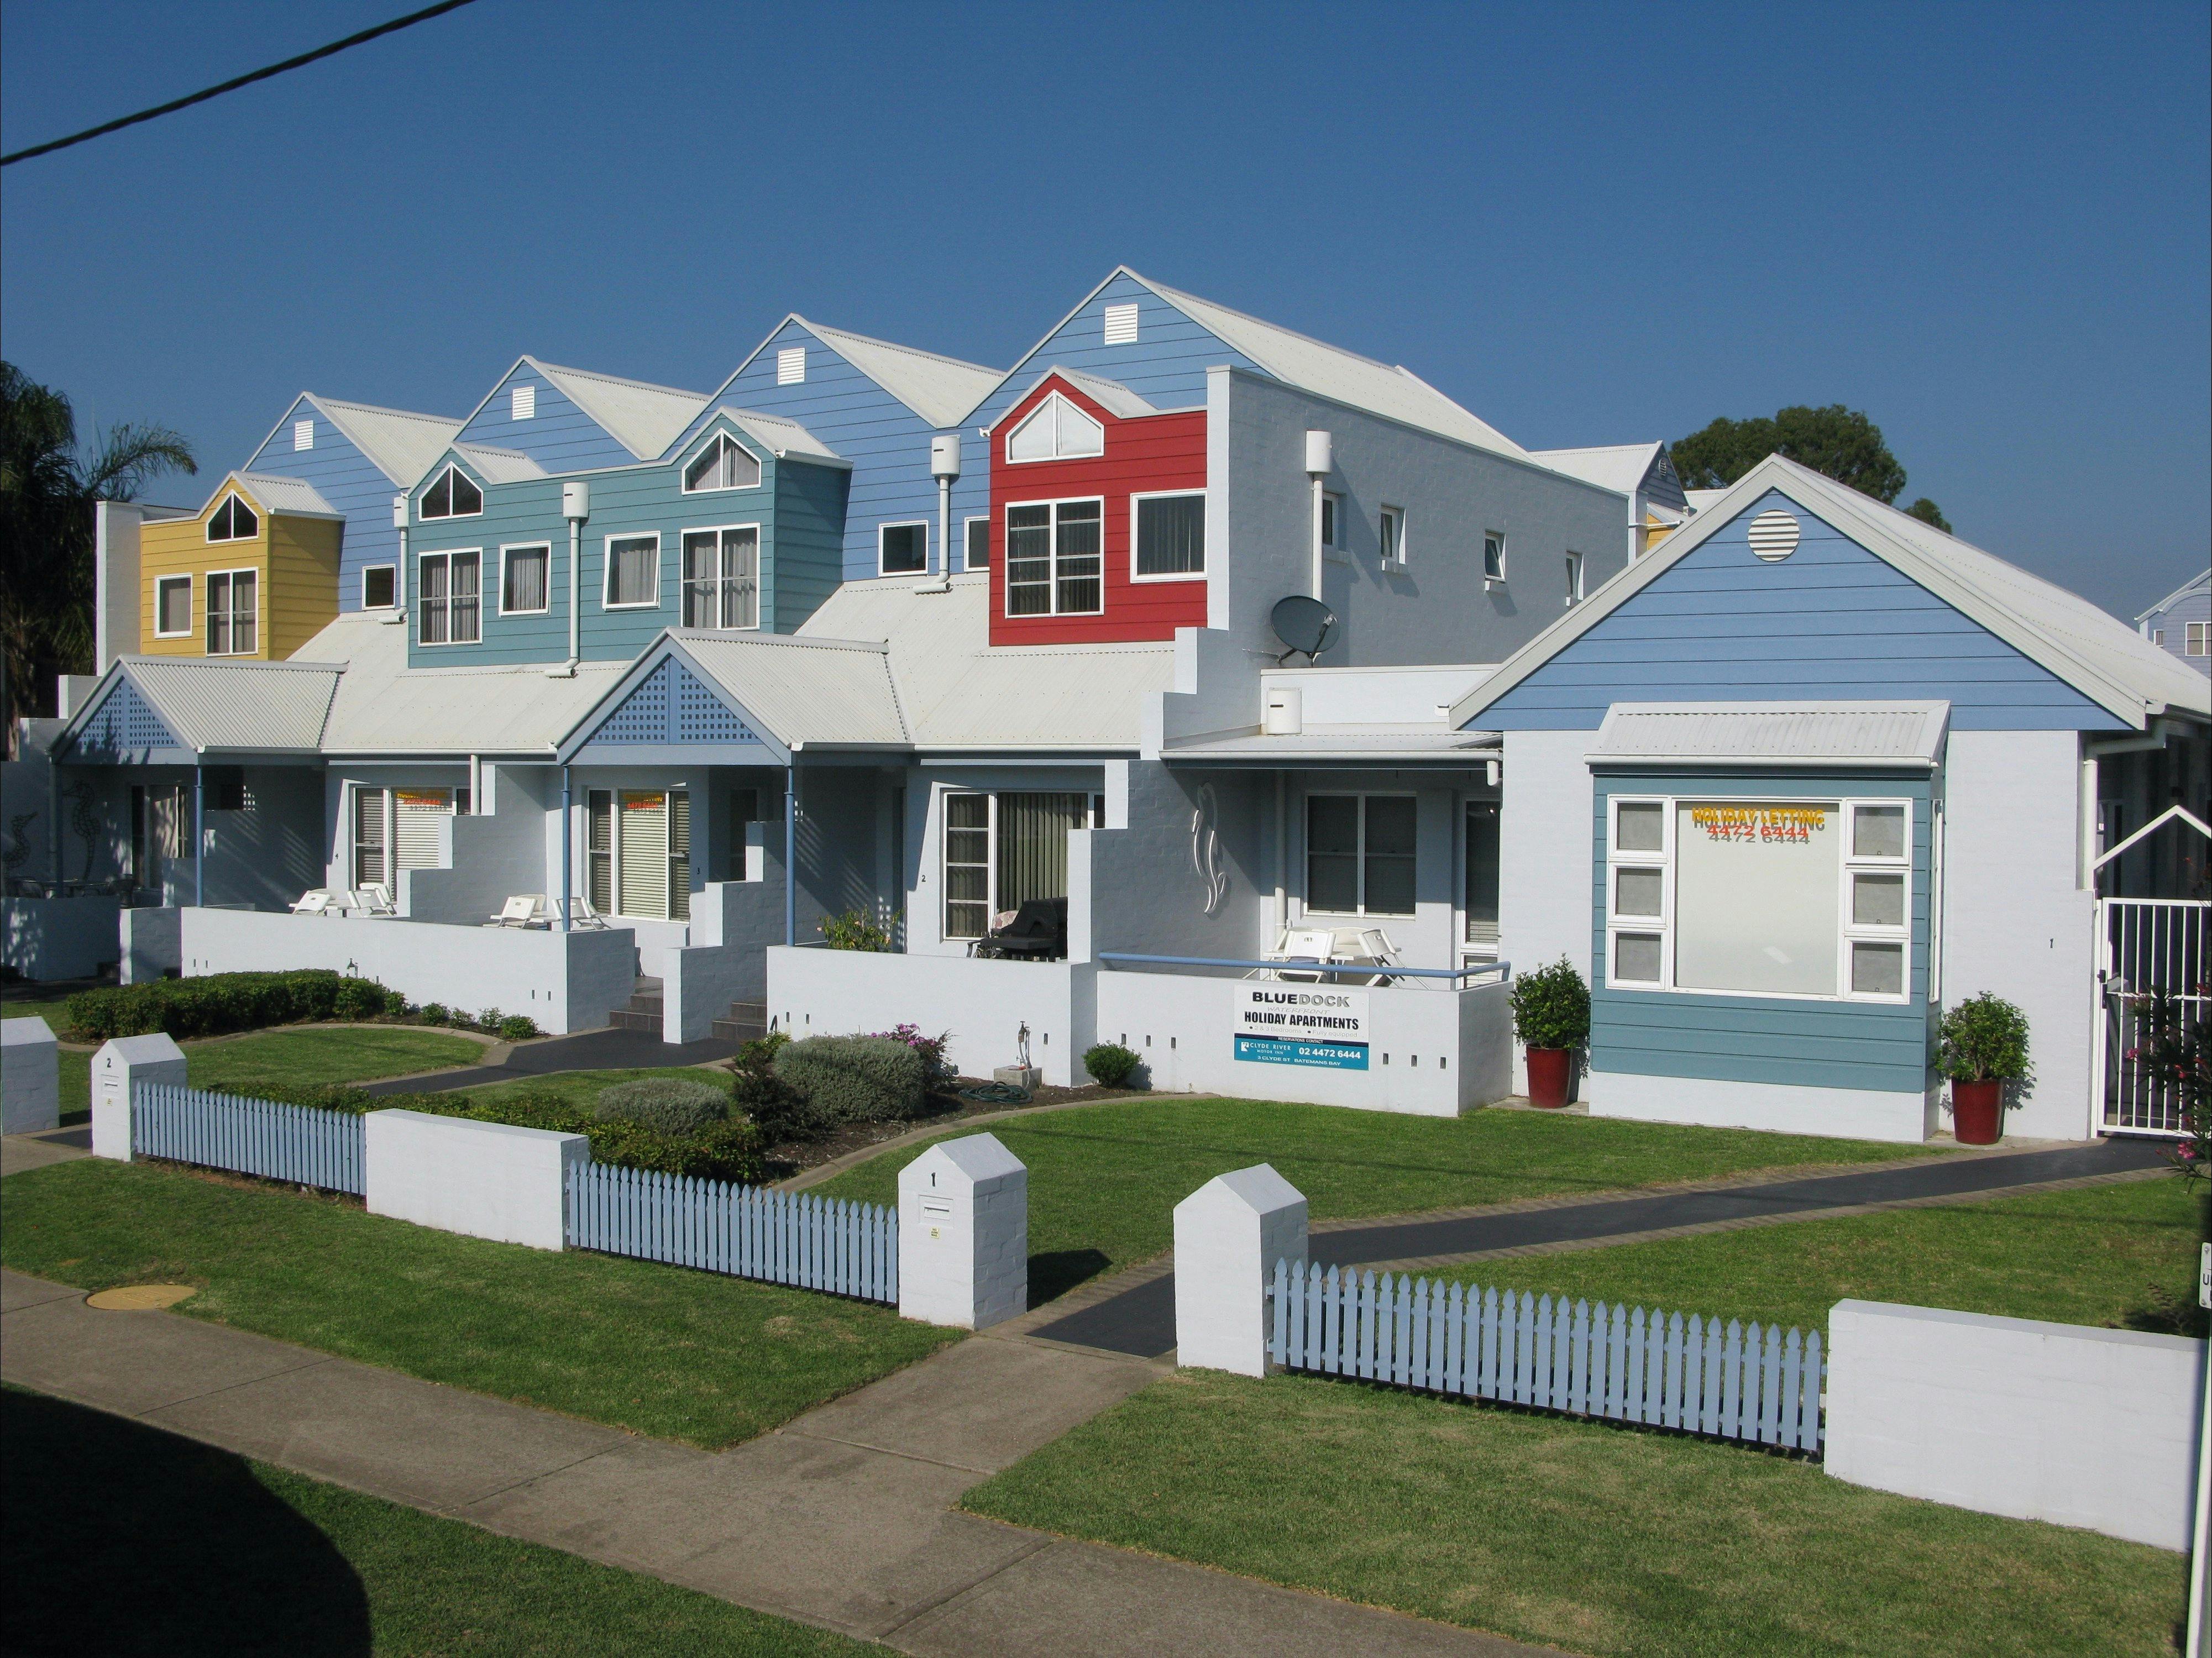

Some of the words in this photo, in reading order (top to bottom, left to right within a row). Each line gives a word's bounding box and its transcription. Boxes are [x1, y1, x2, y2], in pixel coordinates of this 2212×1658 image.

[1692, 807, 1756, 822] HOLIDAY
[1760, 809, 1824, 824] LETTING
[1707, 825, 1755, 836] 4472
[1760, 826, 1809, 838] 6444
[1252, 991, 1350, 1008] BLUEDOCK
[1267, 1006, 1330, 1015] WATERFRONT
[1244, 1011, 1287, 1025] HOLIDAY
[1289, 1014, 1359, 1030] APARTMENTS
[1299, 1047, 1311, 1056] 02
[1312, 1048, 1335, 1057] 4472
[1337, 1050, 1361, 1059] 6444
[107, 1057, 112, 1068] 2
[931, 1172, 936, 1187] 1
